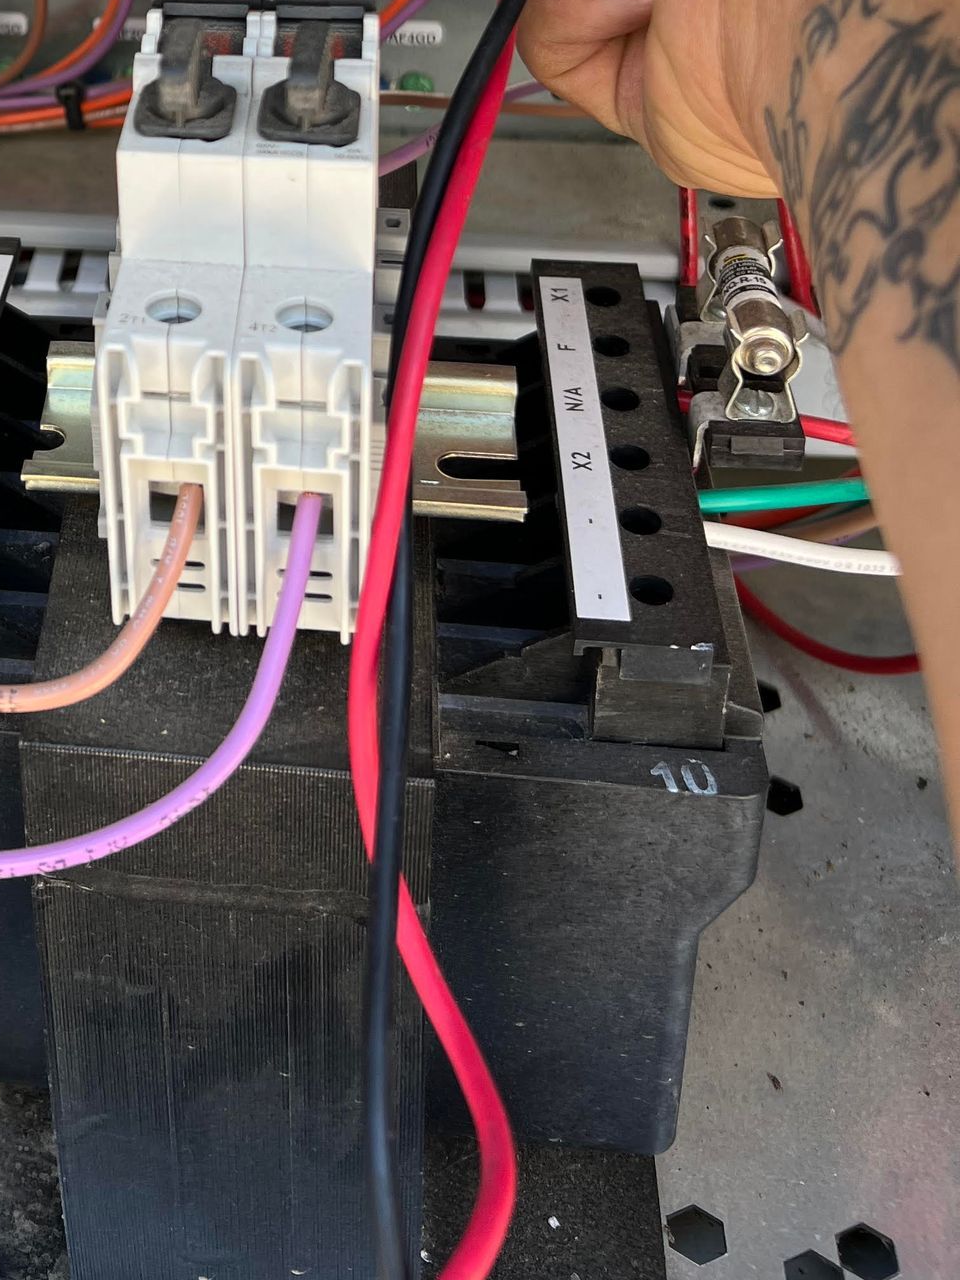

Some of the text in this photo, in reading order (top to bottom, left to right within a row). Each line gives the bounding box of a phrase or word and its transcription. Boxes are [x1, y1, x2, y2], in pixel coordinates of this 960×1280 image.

[551, 287, 568, 302] X1
[559, 342, 574, 353] F
[564, 385, 585, 412] N/A
[573, 450, 593, 472] X2
